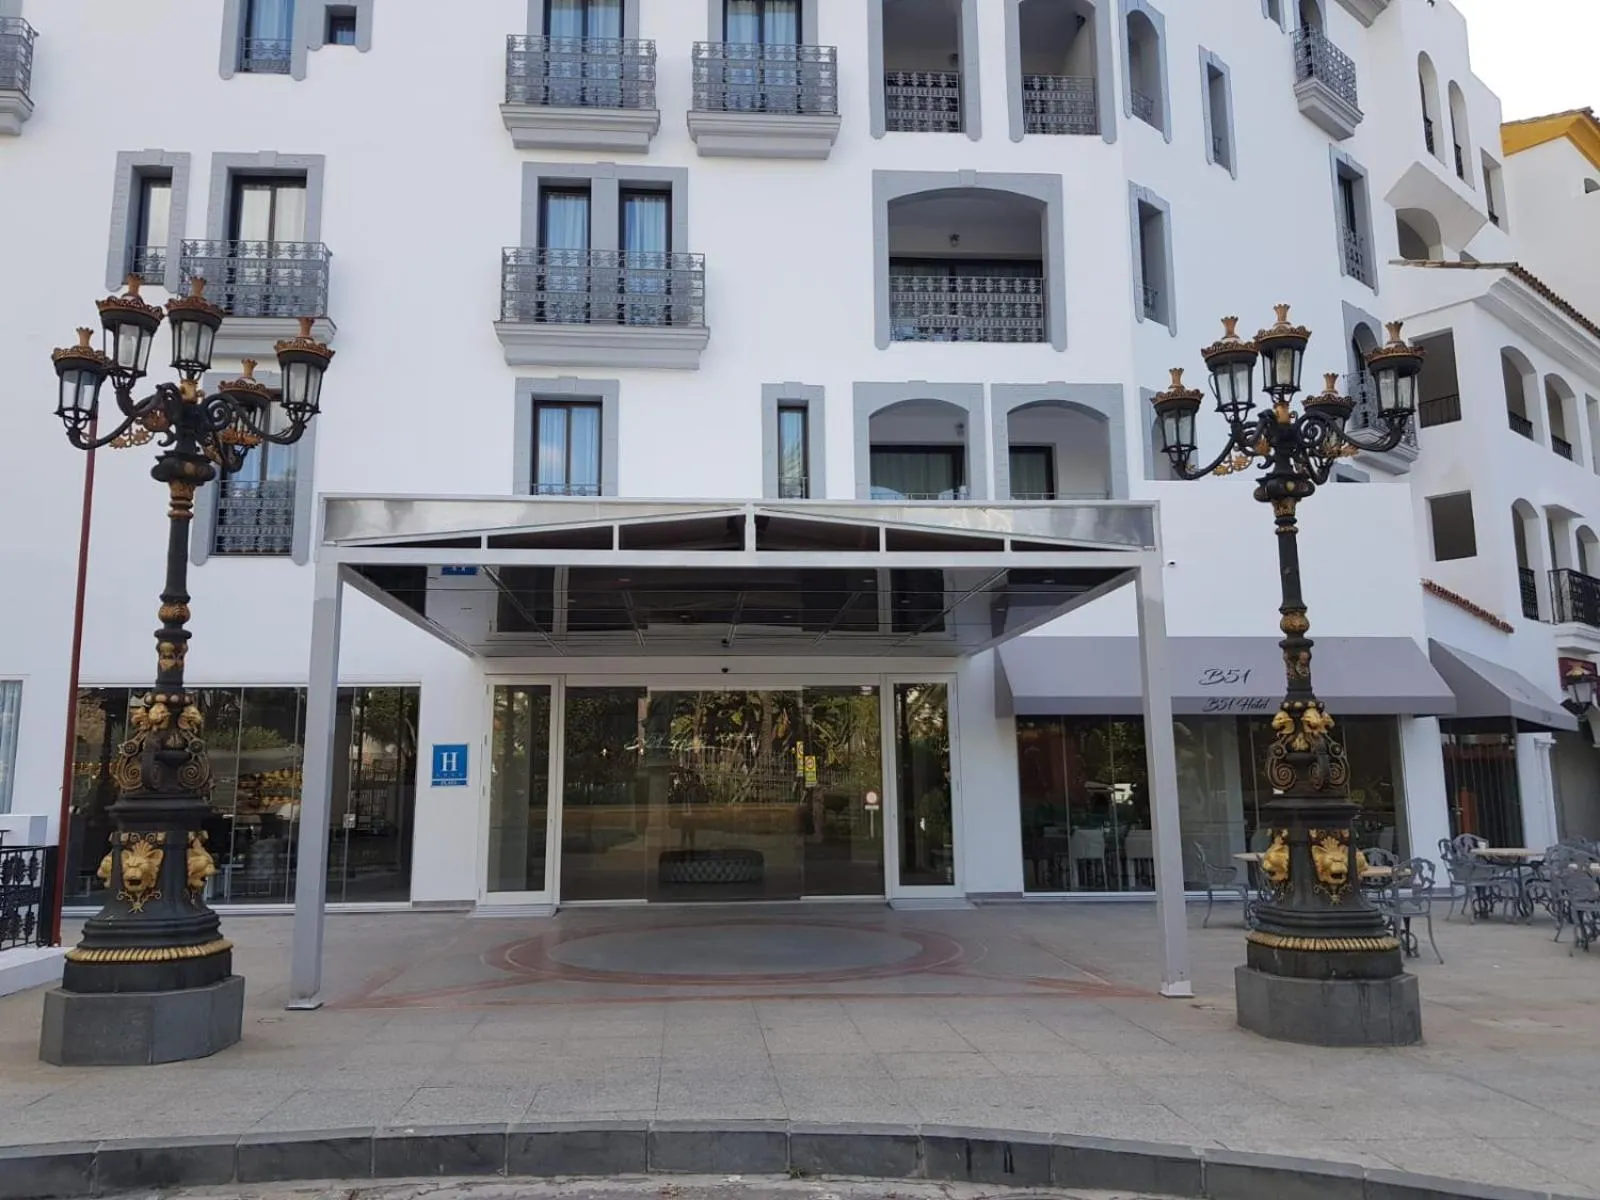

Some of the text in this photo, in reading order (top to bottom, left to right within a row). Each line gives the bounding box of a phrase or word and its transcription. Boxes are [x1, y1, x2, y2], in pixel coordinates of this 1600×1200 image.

[1199, 669, 1251, 685] B51
[1202, 697, 1270, 712] B51 Hotel
[440, 751, 458, 771] H
